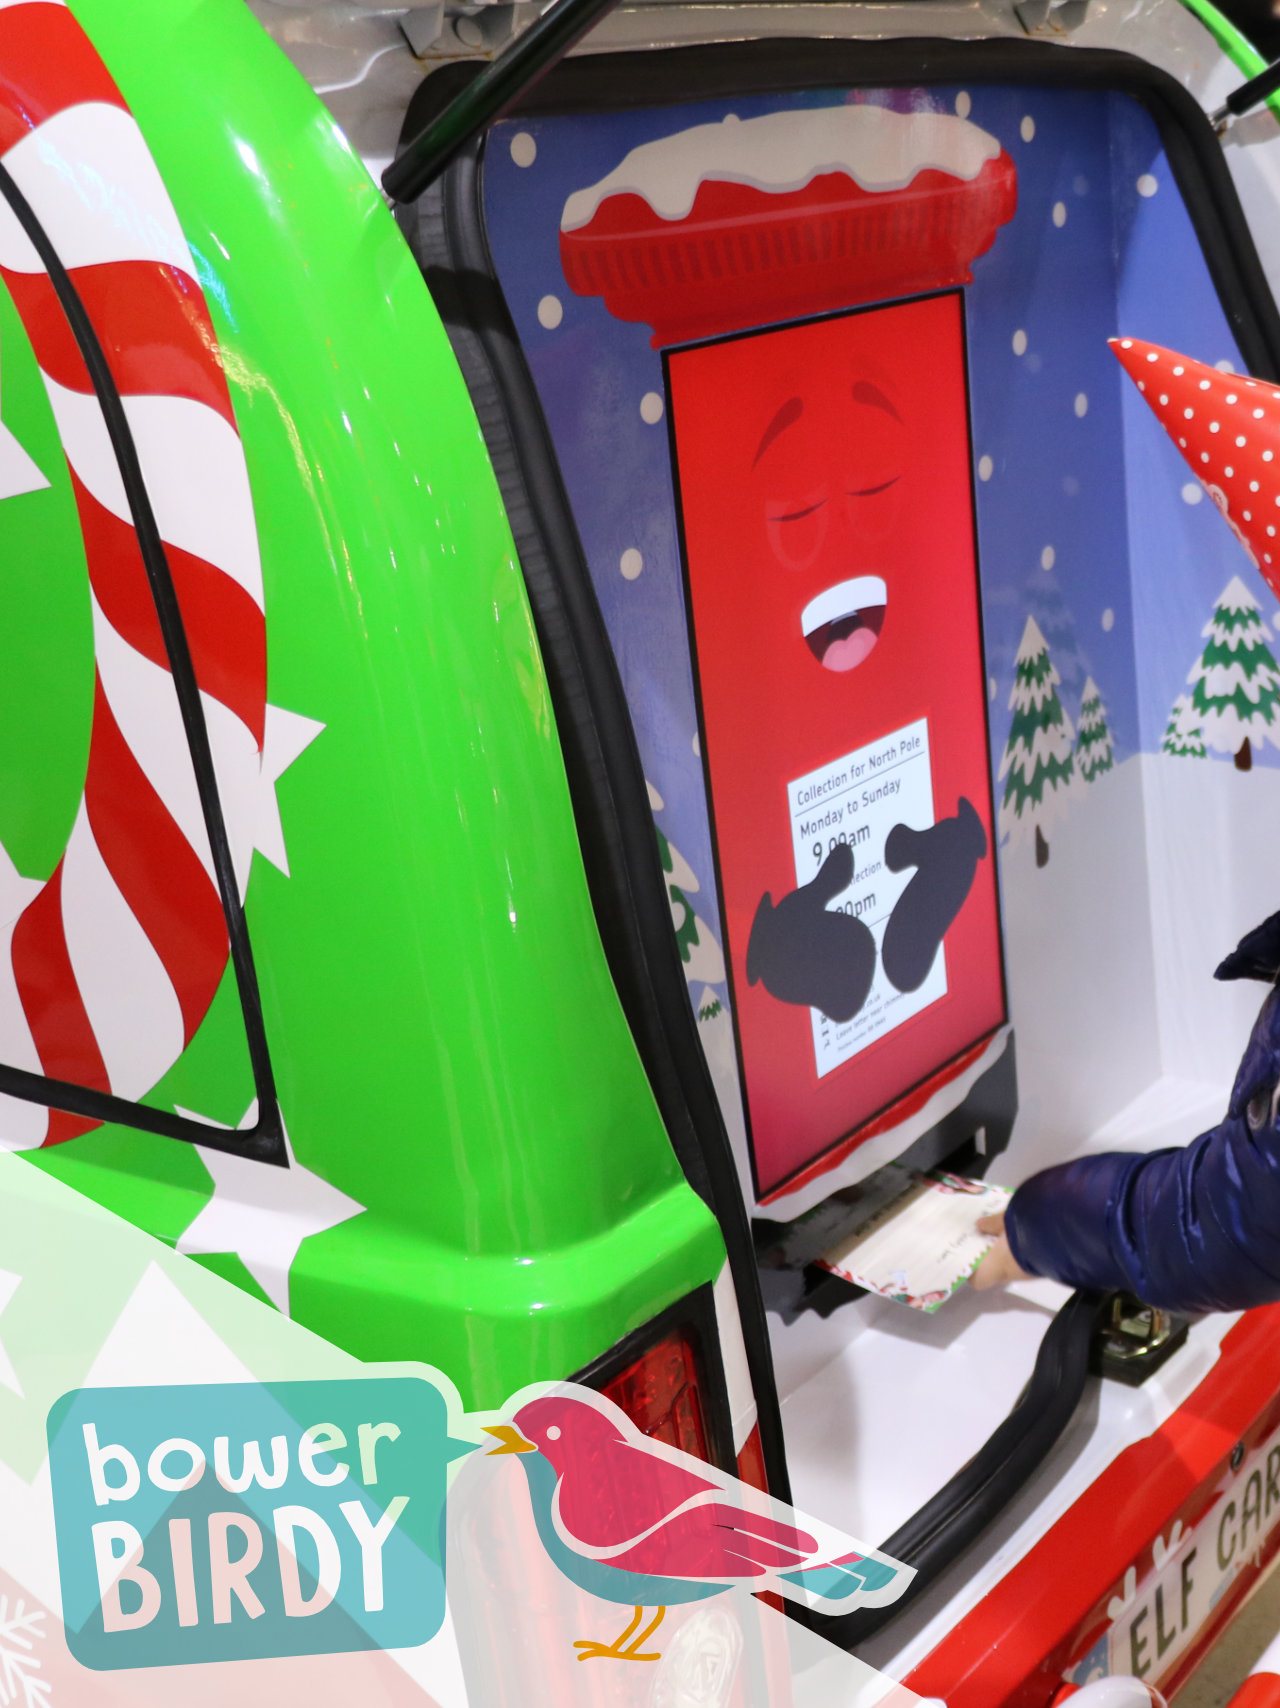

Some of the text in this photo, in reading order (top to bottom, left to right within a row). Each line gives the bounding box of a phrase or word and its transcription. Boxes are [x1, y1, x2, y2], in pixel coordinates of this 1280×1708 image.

[797, 736, 920, 806] Collection for North Pole
[800, 778, 901, 840] Monday to Sunday
[812, 825, 871, 867] 900am
[1129, 1547, 1198, 1679] ELF
